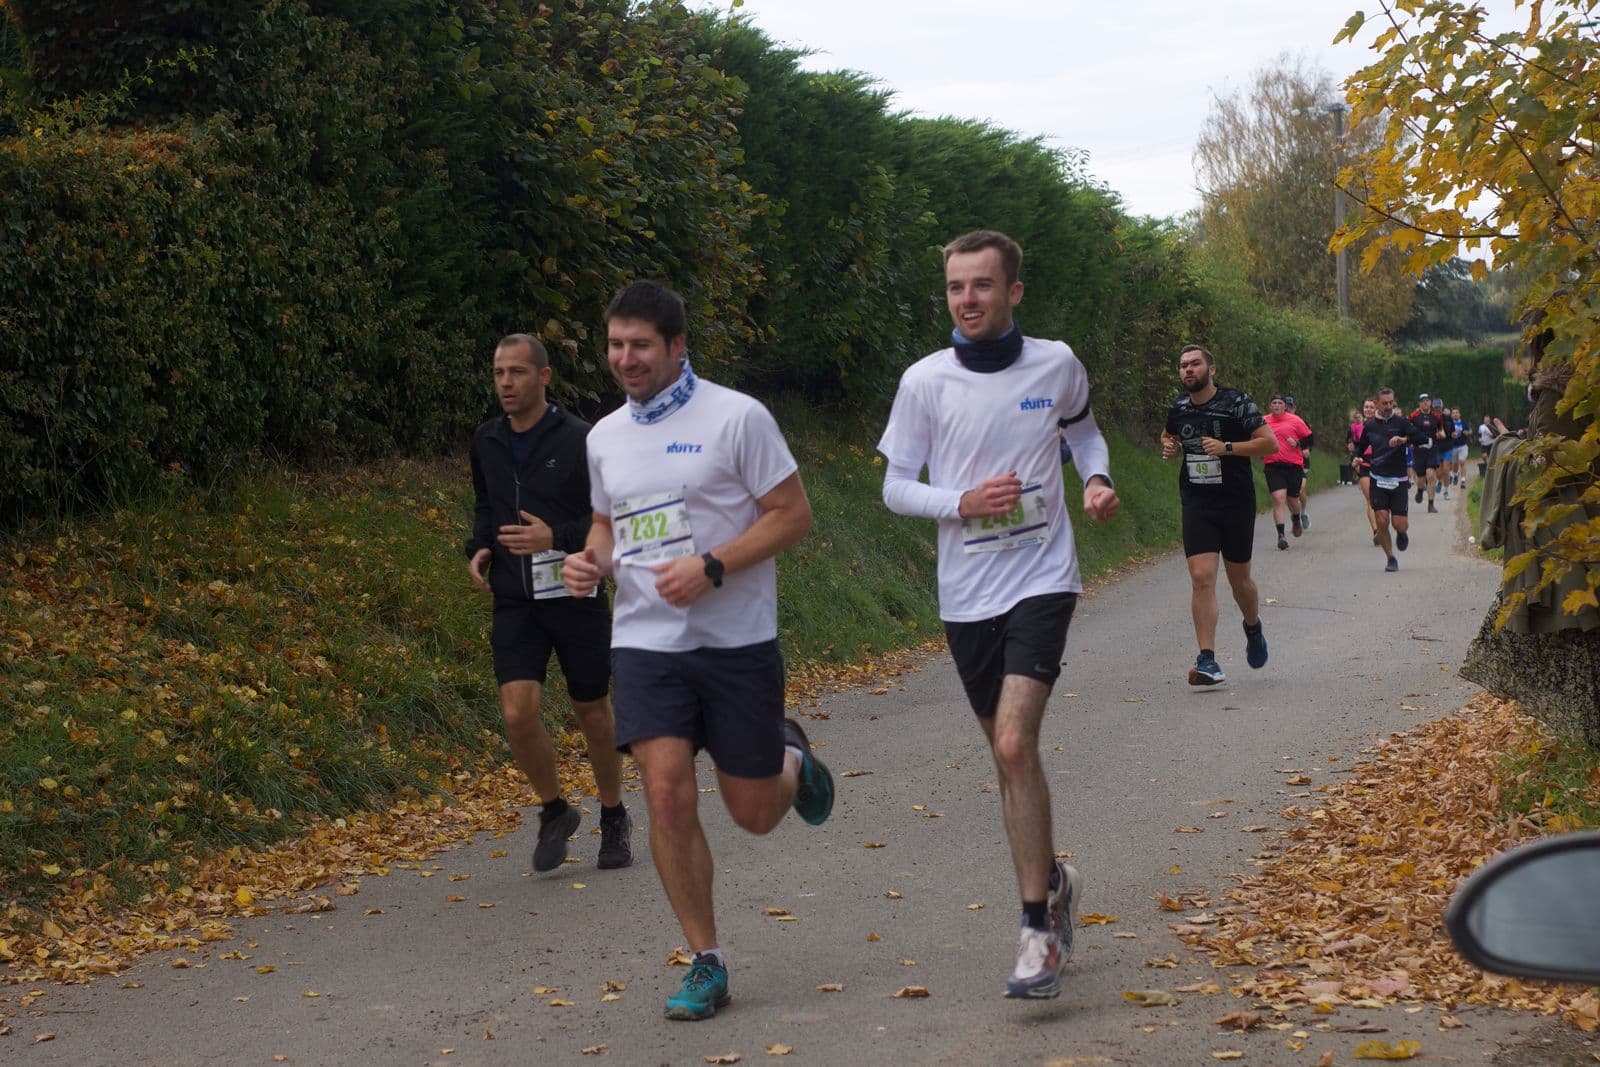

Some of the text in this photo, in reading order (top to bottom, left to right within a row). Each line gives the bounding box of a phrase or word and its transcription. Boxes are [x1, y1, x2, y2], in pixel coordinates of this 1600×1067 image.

[1020, 397, 1054, 410] RUITZ
[666, 441, 703, 454] RUITZ
[1195, 463, 1209, 475] 49
[630, 511, 670, 542] 232
